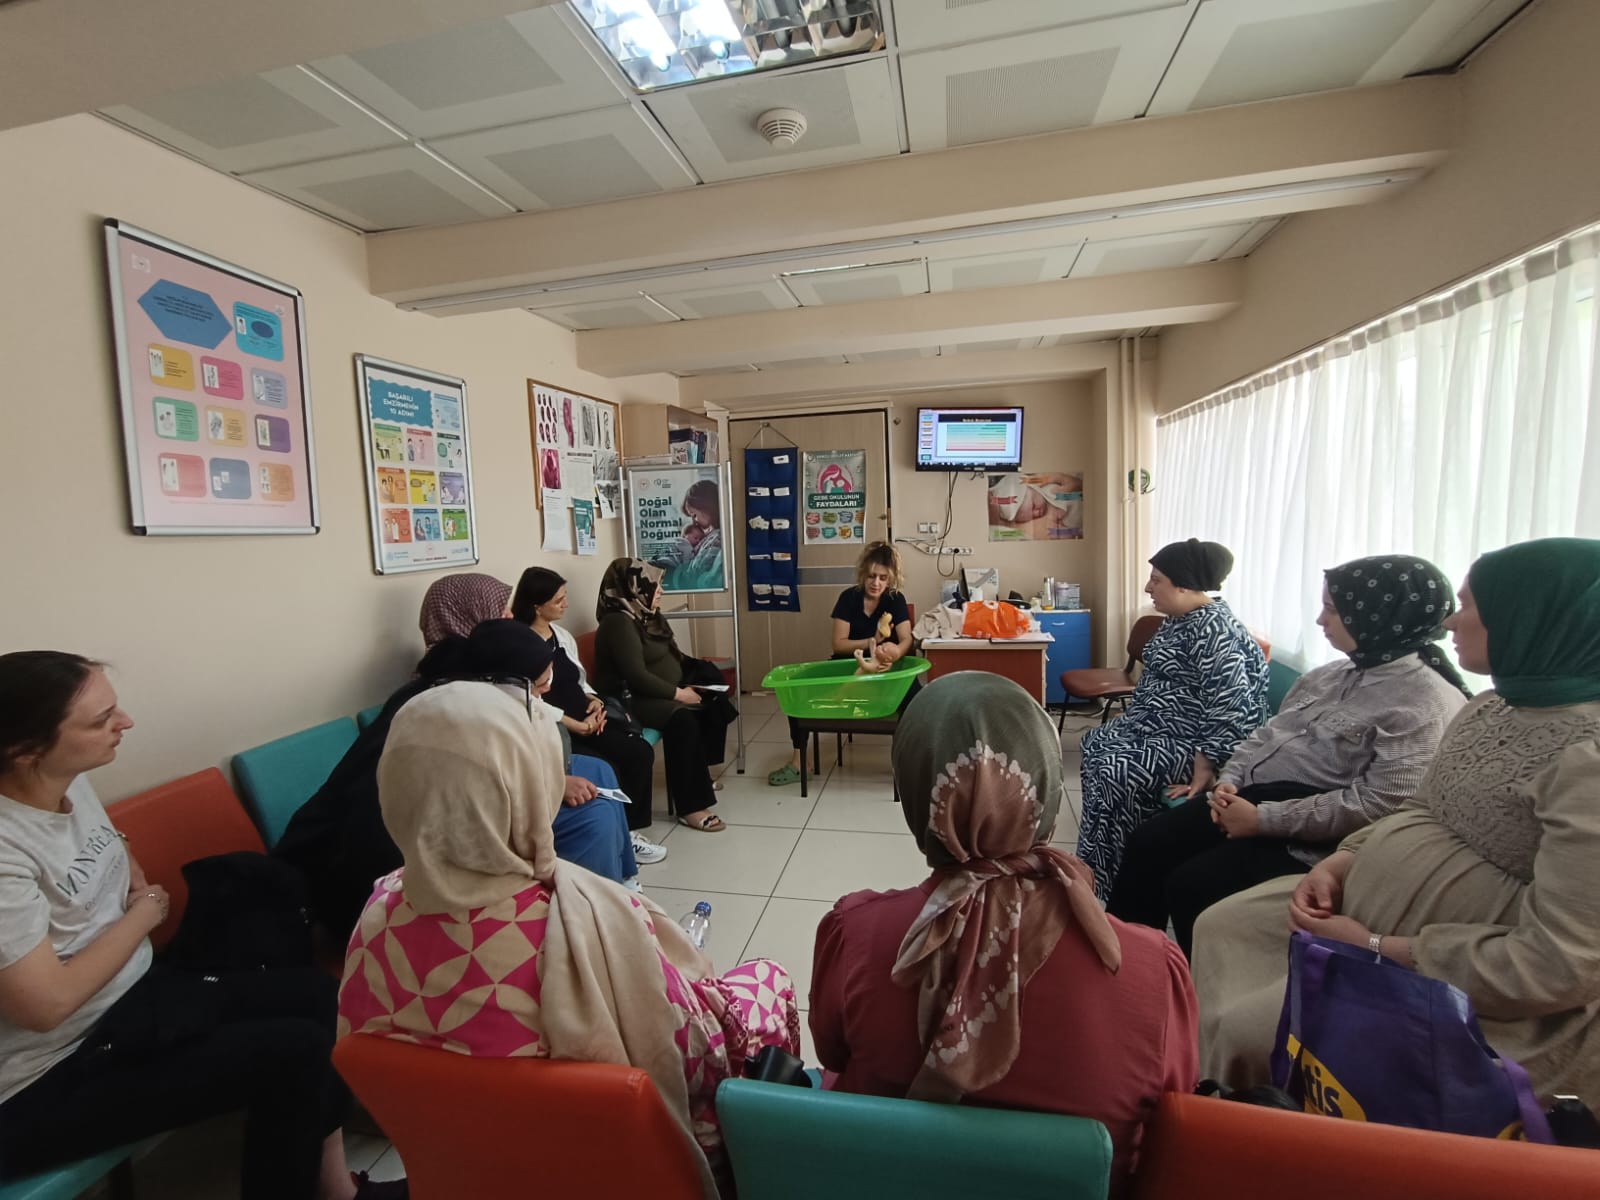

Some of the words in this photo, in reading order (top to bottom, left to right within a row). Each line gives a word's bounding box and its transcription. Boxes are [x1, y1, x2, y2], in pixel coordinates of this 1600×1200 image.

[638, 496, 672, 509] Doğal
[816, 500, 857, 508] FAYDALARI
[639, 508, 666, 518] Olan
[640, 518, 682, 529] Normal
[641, 529, 682, 540] Doğum
